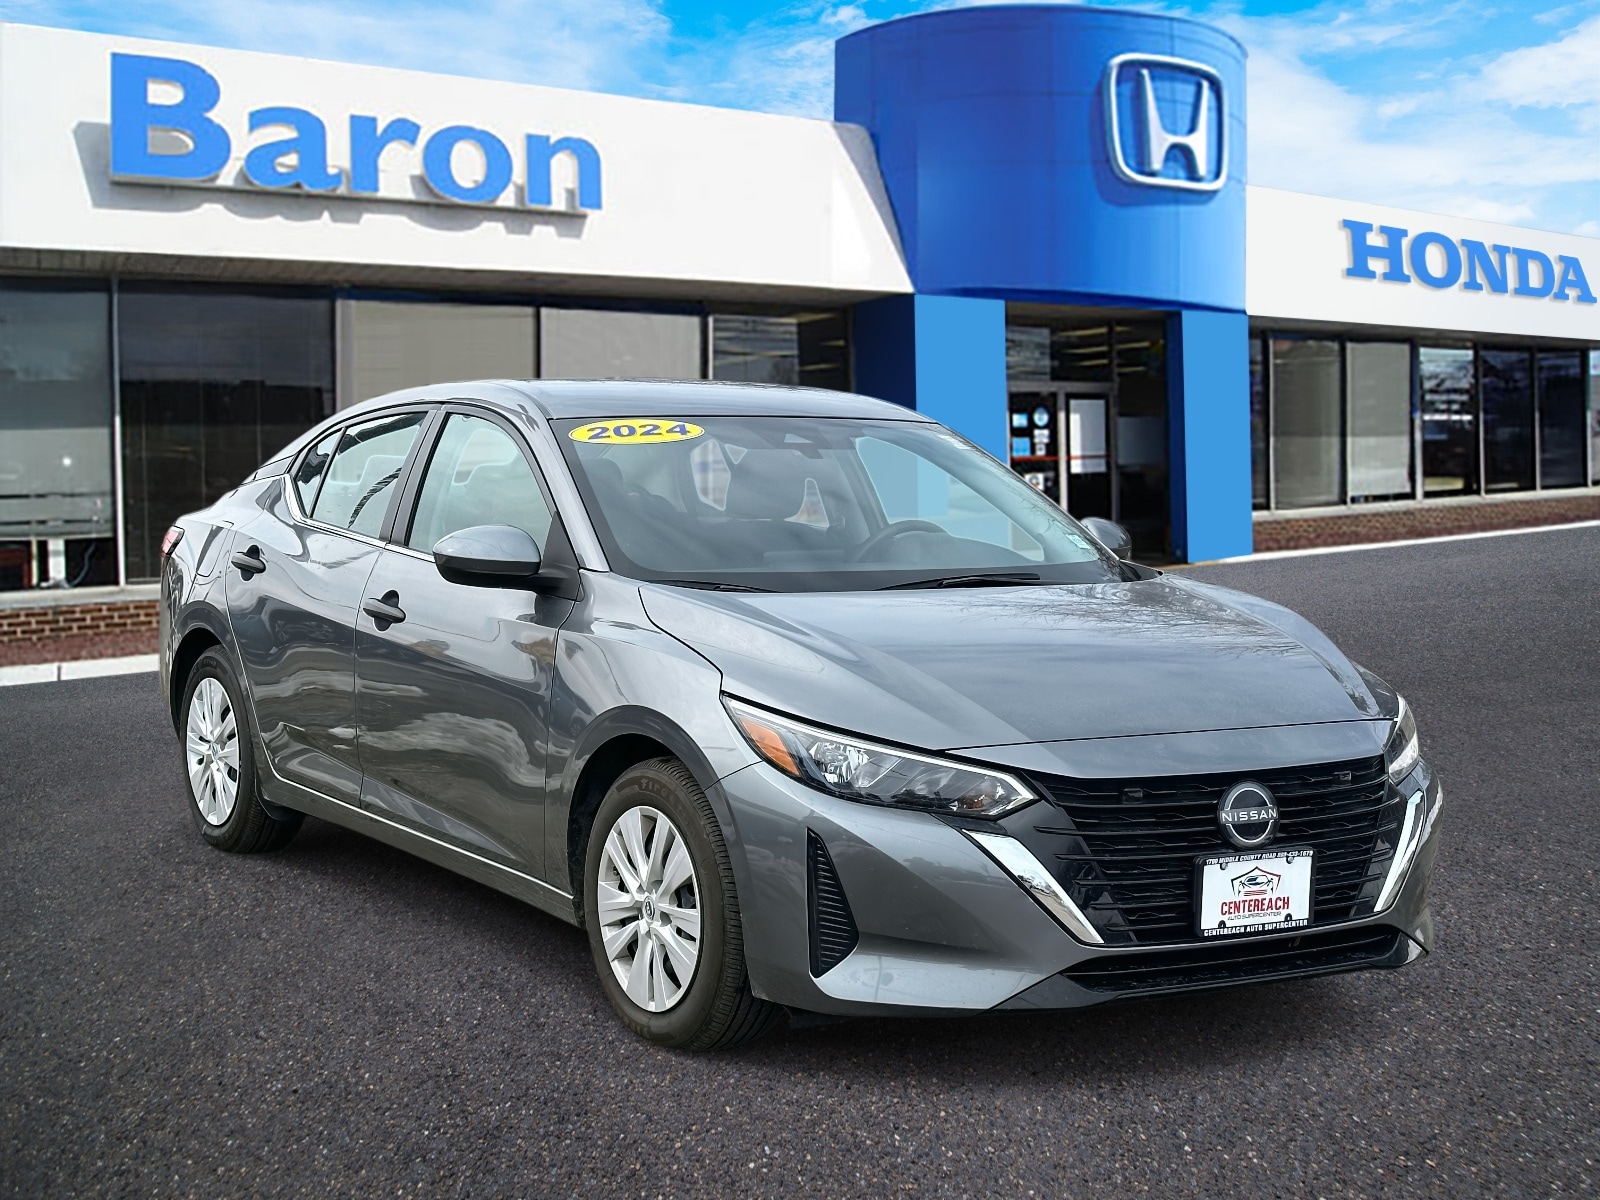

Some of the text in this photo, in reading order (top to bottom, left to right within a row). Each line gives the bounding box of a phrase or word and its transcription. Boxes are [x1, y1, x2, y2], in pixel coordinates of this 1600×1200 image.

[110, 53, 604, 210] Baron
[1342, 219, 1597, 303] HONDA
[587, 424, 690, 440] 2024
[1222, 808, 1276, 821] NISSAN
[1219, 856, 1239, 864] MIDDLE
[1221, 896, 1290, 915] CENTEREACH
[1242, 911, 1282, 920] SUPERCENTER
[1204, 919, 1308, 936] CENTEREACH AUTO SUPERCENTER
